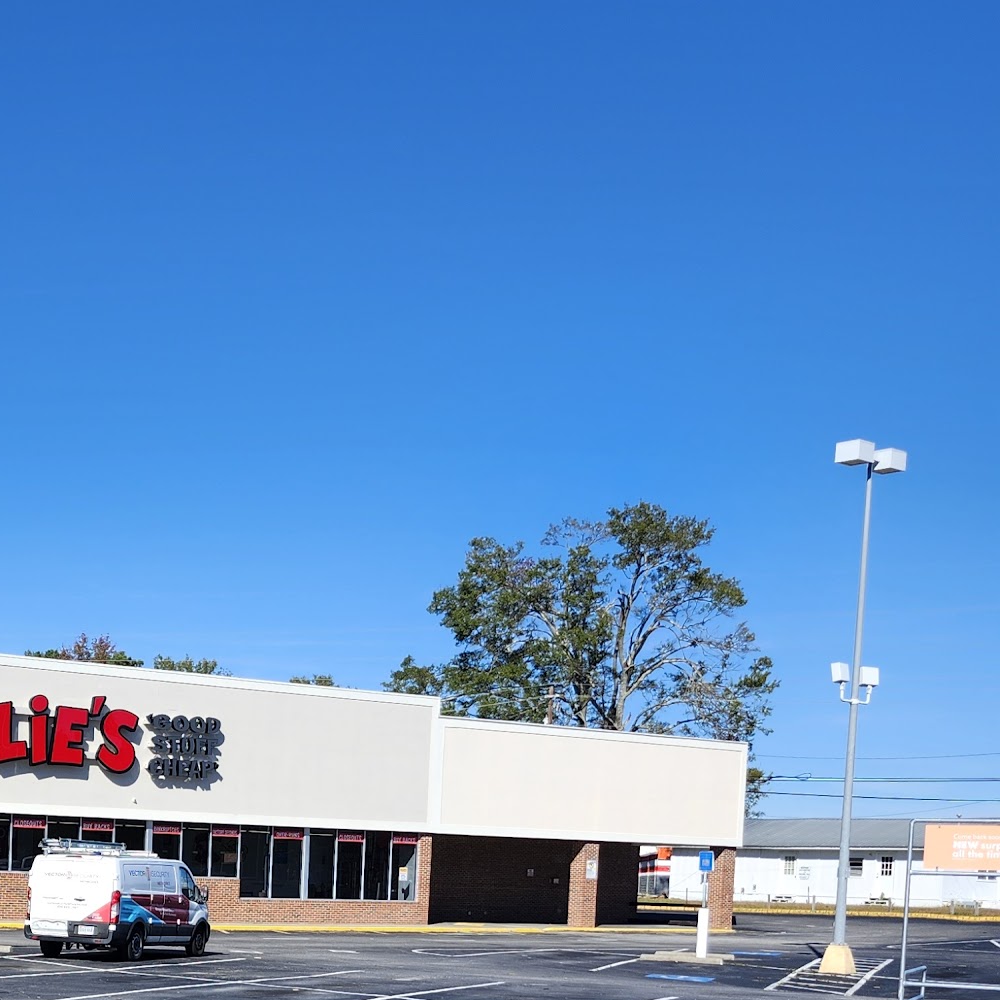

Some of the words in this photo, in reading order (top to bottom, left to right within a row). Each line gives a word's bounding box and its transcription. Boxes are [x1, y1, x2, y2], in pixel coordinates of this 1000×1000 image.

[151, 735, 219, 756] STUFF
[13, 819, 43, 827] CLOSEOUTS
[952, 840, 979, 849] NEW
[952, 849, 965, 858] all
[967, 849, 984, 858] the
[128, 869, 145, 877] VECTOR
[151, 870, 170, 878] SECURITY
